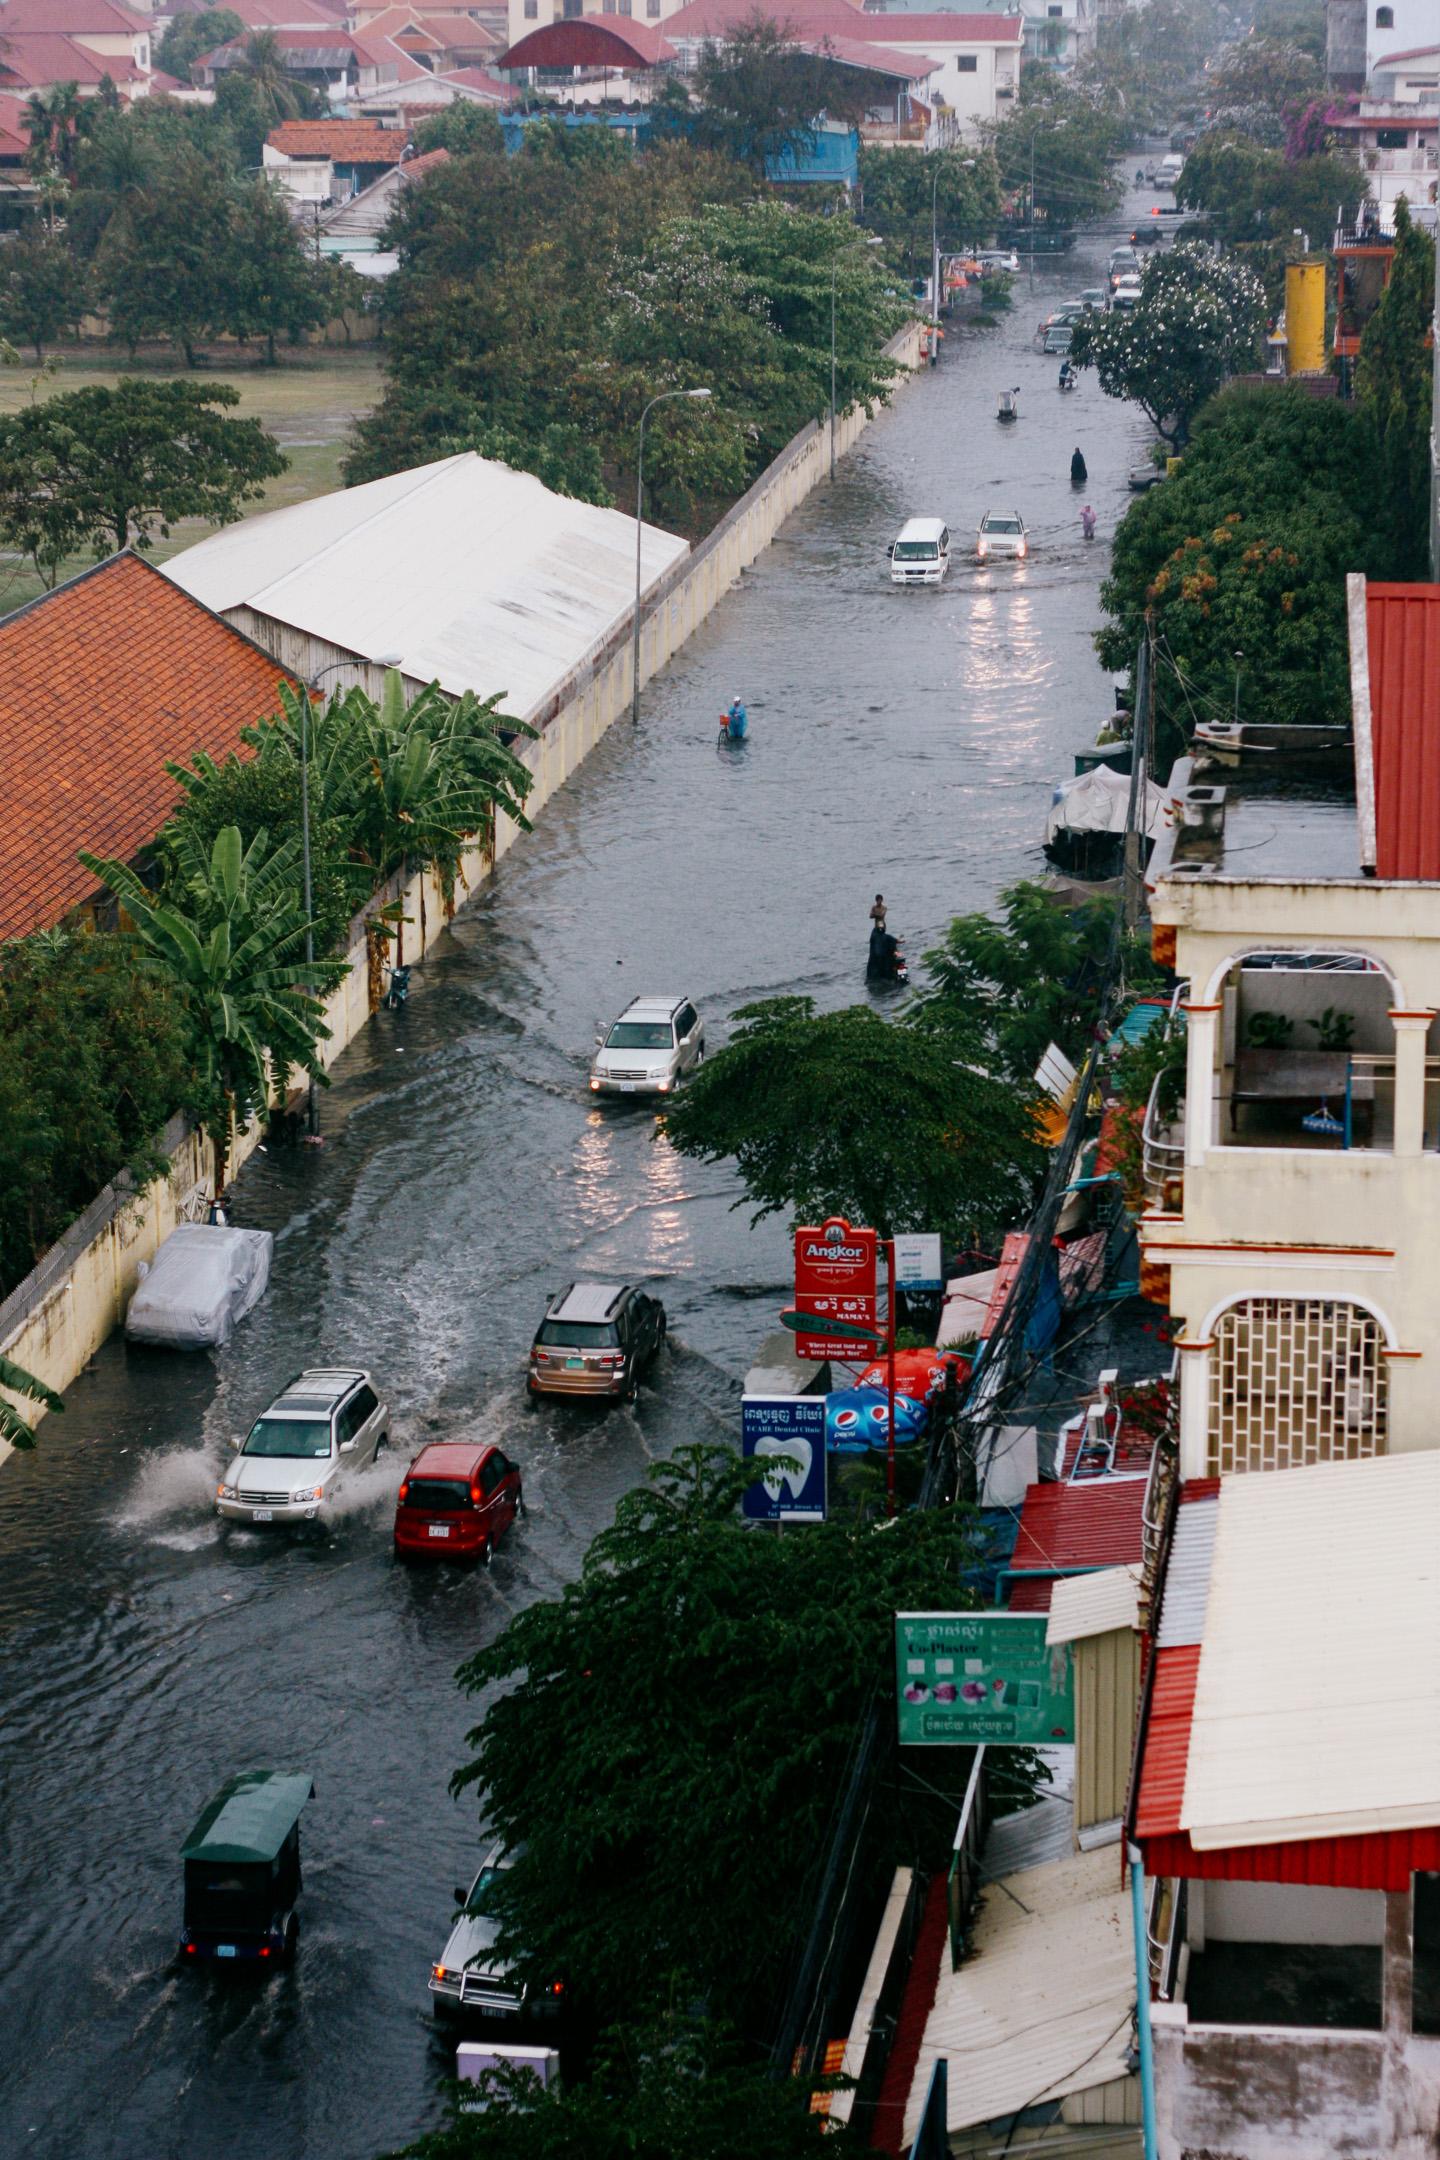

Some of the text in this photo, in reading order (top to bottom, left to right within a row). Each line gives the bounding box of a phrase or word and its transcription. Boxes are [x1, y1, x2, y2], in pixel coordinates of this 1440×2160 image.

[806, 1244, 864, 1260] Angkor
[774, 1425, 798, 1433] Dental
[799, 1425, 821, 1433] Clinic
[834, 1430, 856, 1439] pepsi
